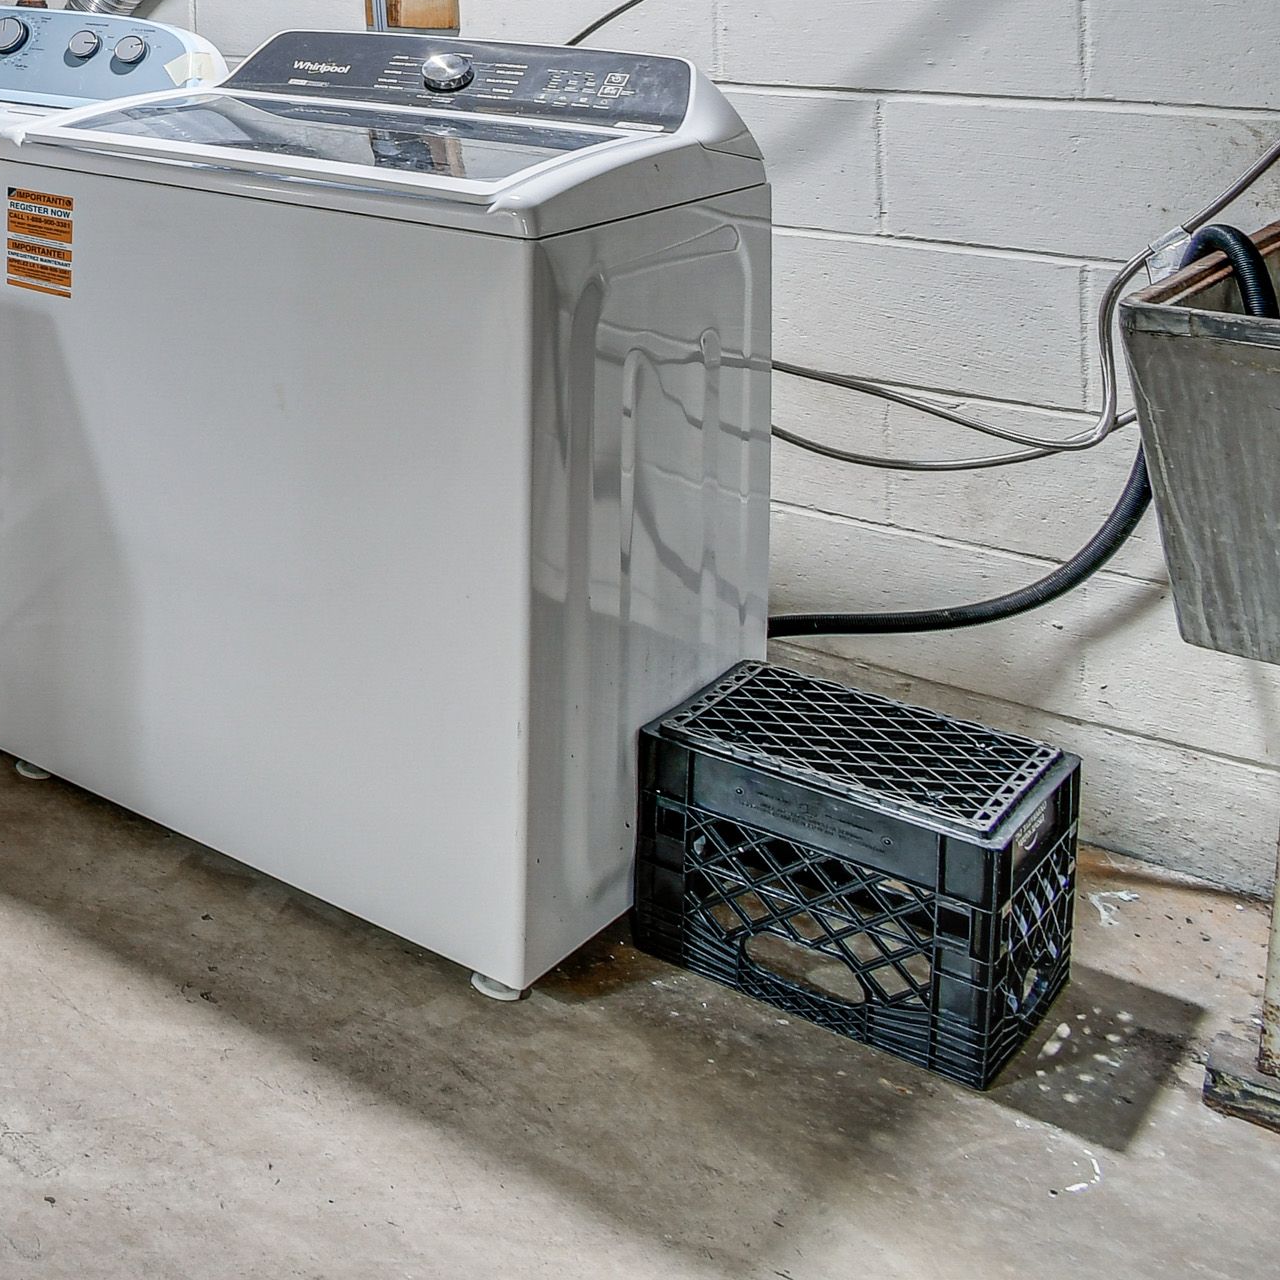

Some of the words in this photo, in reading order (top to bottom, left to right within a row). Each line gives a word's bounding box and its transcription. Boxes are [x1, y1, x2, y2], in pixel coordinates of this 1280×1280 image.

[293, 60, 351, 75] Whirlpool
[16, 189, 65, 205] IMPORTANT!
[8, 212, 24, 221] CALL
[9, 201, 49, 215] REGISTER
[50, 208, 71, 219] NOW
